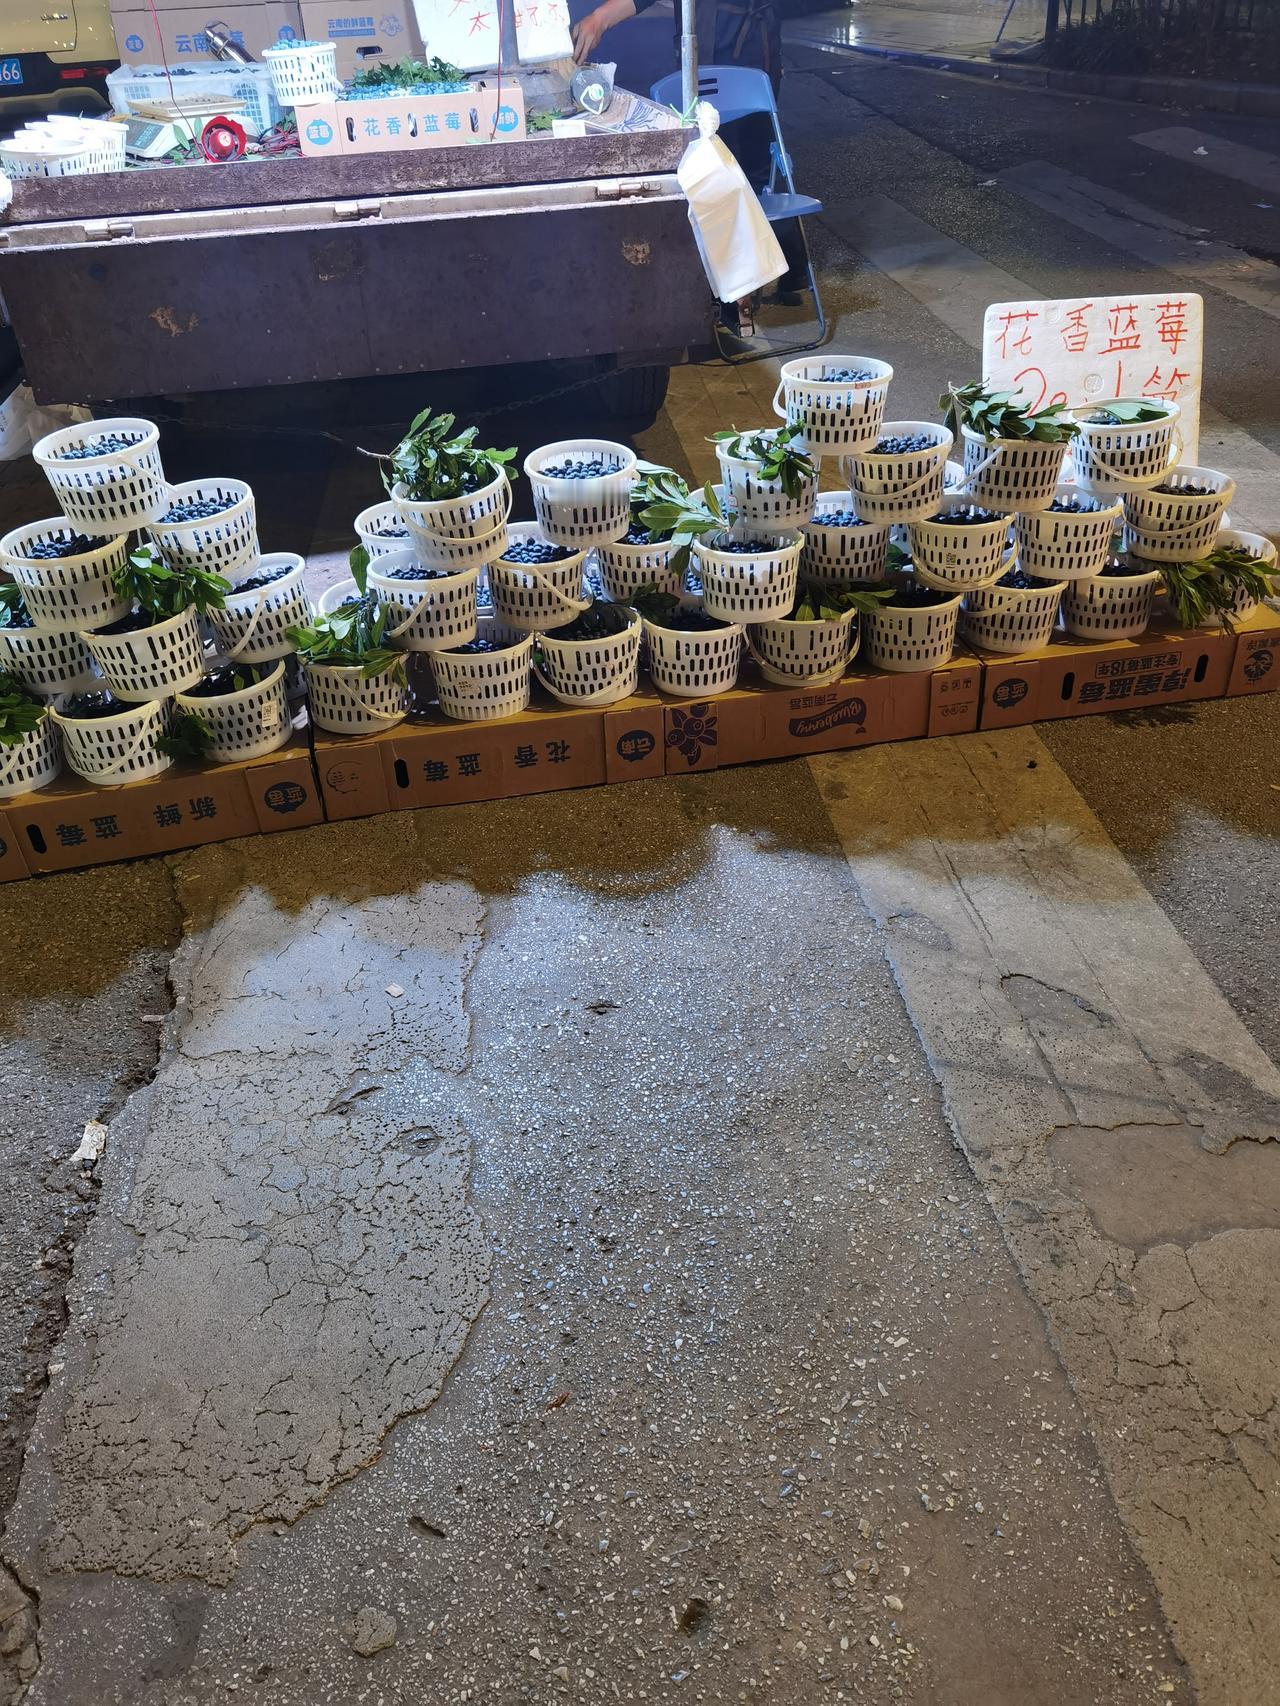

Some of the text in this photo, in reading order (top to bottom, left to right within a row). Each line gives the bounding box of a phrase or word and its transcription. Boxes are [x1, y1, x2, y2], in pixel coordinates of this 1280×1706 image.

[0, 63, 20, 80] 66
[362, 112, 462, 137] 花香蓝莓
[994, 301, 1189, 359] 花香蓝莓
[795, 700, 862, 734] Blueberry
[423, 740, 571, 783] 花香蓝莓
[620, 738, 651, 754] 云南
[56, 796, 217, 846] 新鲜蓝莓
